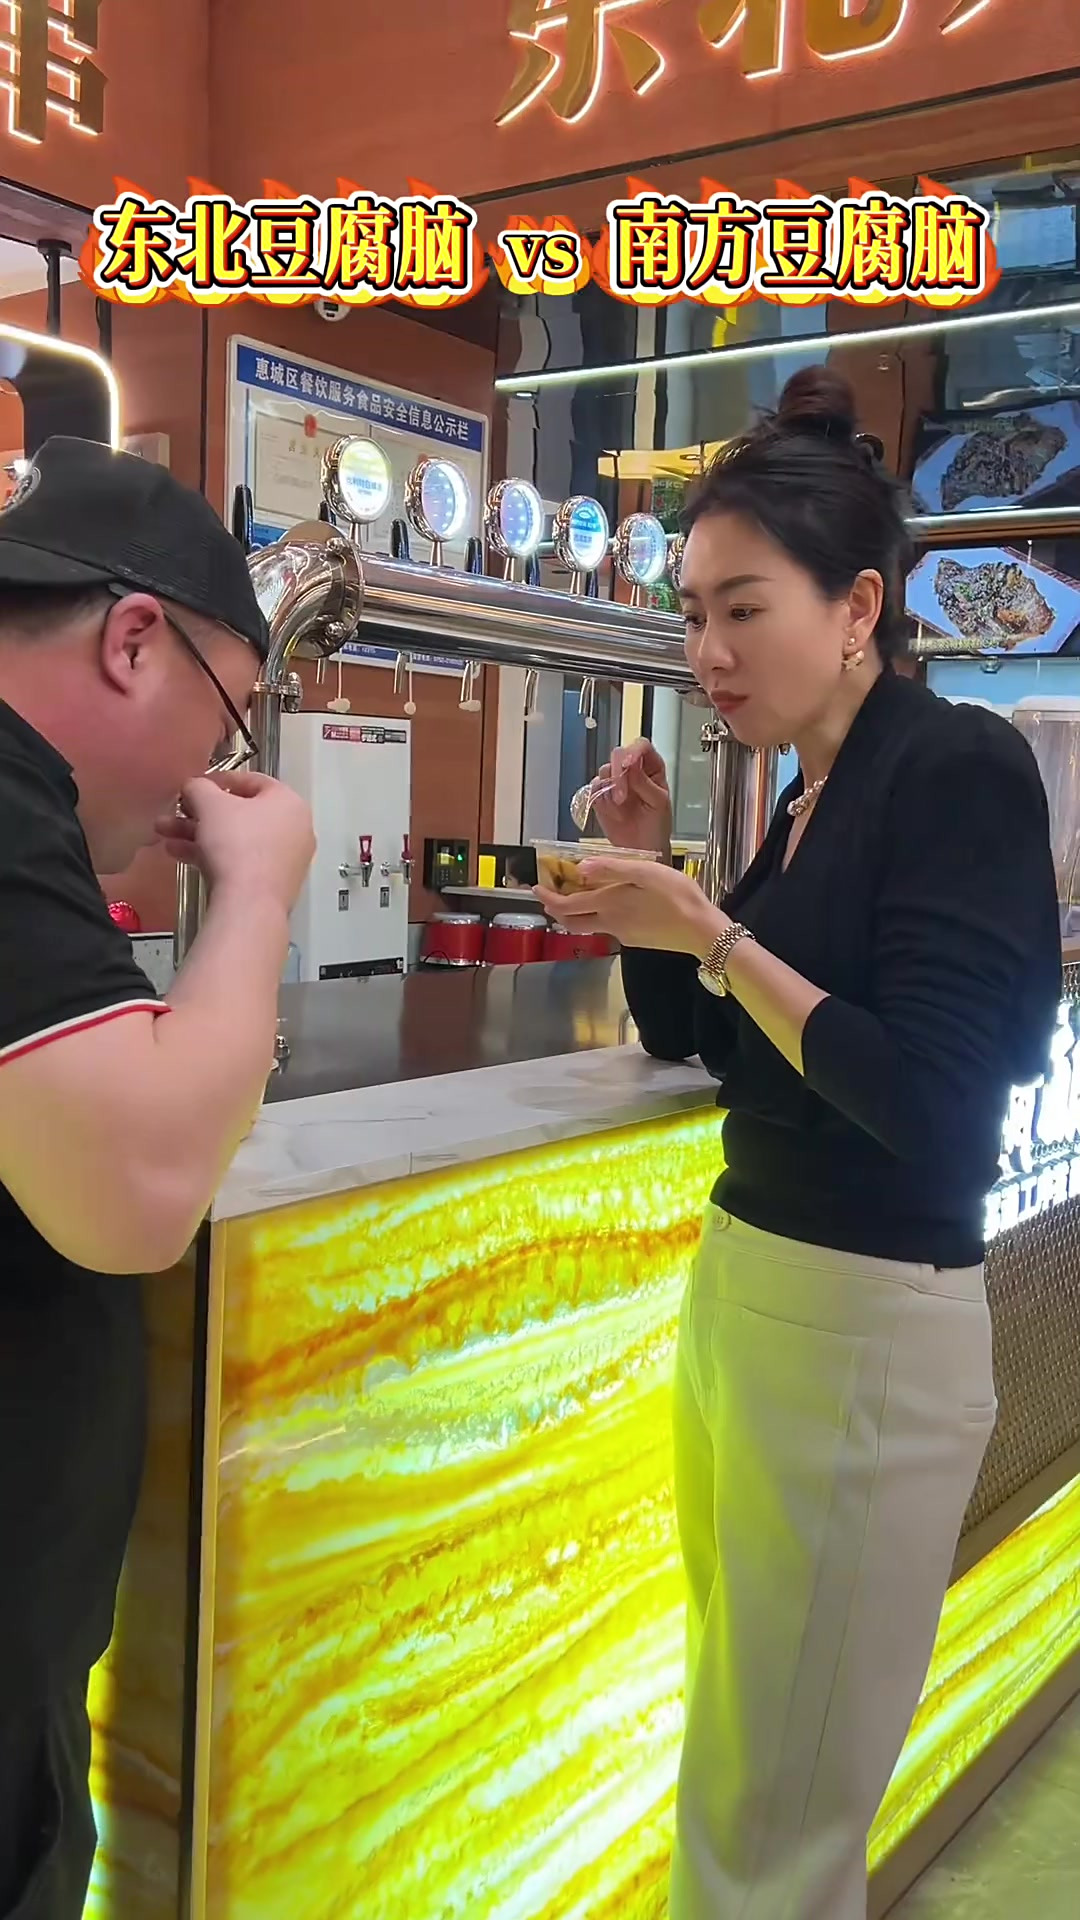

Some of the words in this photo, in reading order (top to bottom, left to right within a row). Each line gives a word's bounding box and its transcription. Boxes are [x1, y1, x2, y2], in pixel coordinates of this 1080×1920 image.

[255, 357, 470, 441] 惠城区餐饮服务食品安全信息公示栏
